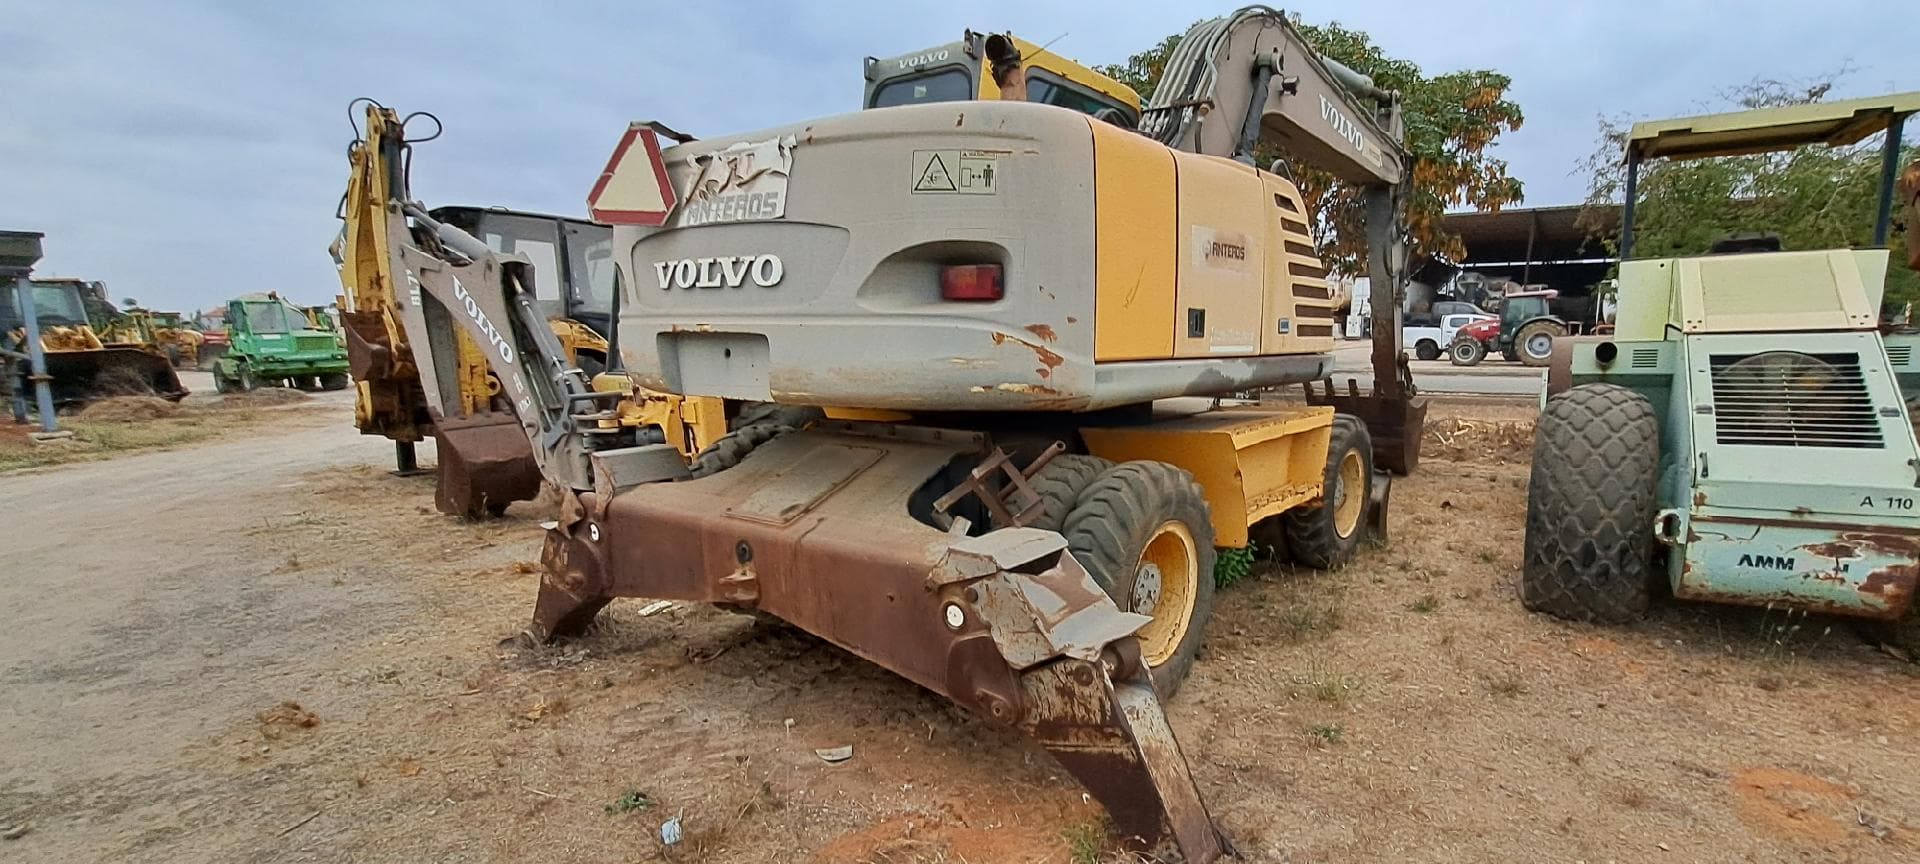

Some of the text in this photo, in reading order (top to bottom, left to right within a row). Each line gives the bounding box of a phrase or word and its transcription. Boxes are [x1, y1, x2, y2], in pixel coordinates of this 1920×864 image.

[899, 50, 949, 69] VOLVO
[1319, 93, 1364, 151] VOLVO
[1212, 242, 1246, 260] ANTEROS
[653, 254, 784, 289] VOLVO
[452, 274, 514, 364] VOLVO
[1860, 496, 1913, 510] A 110
